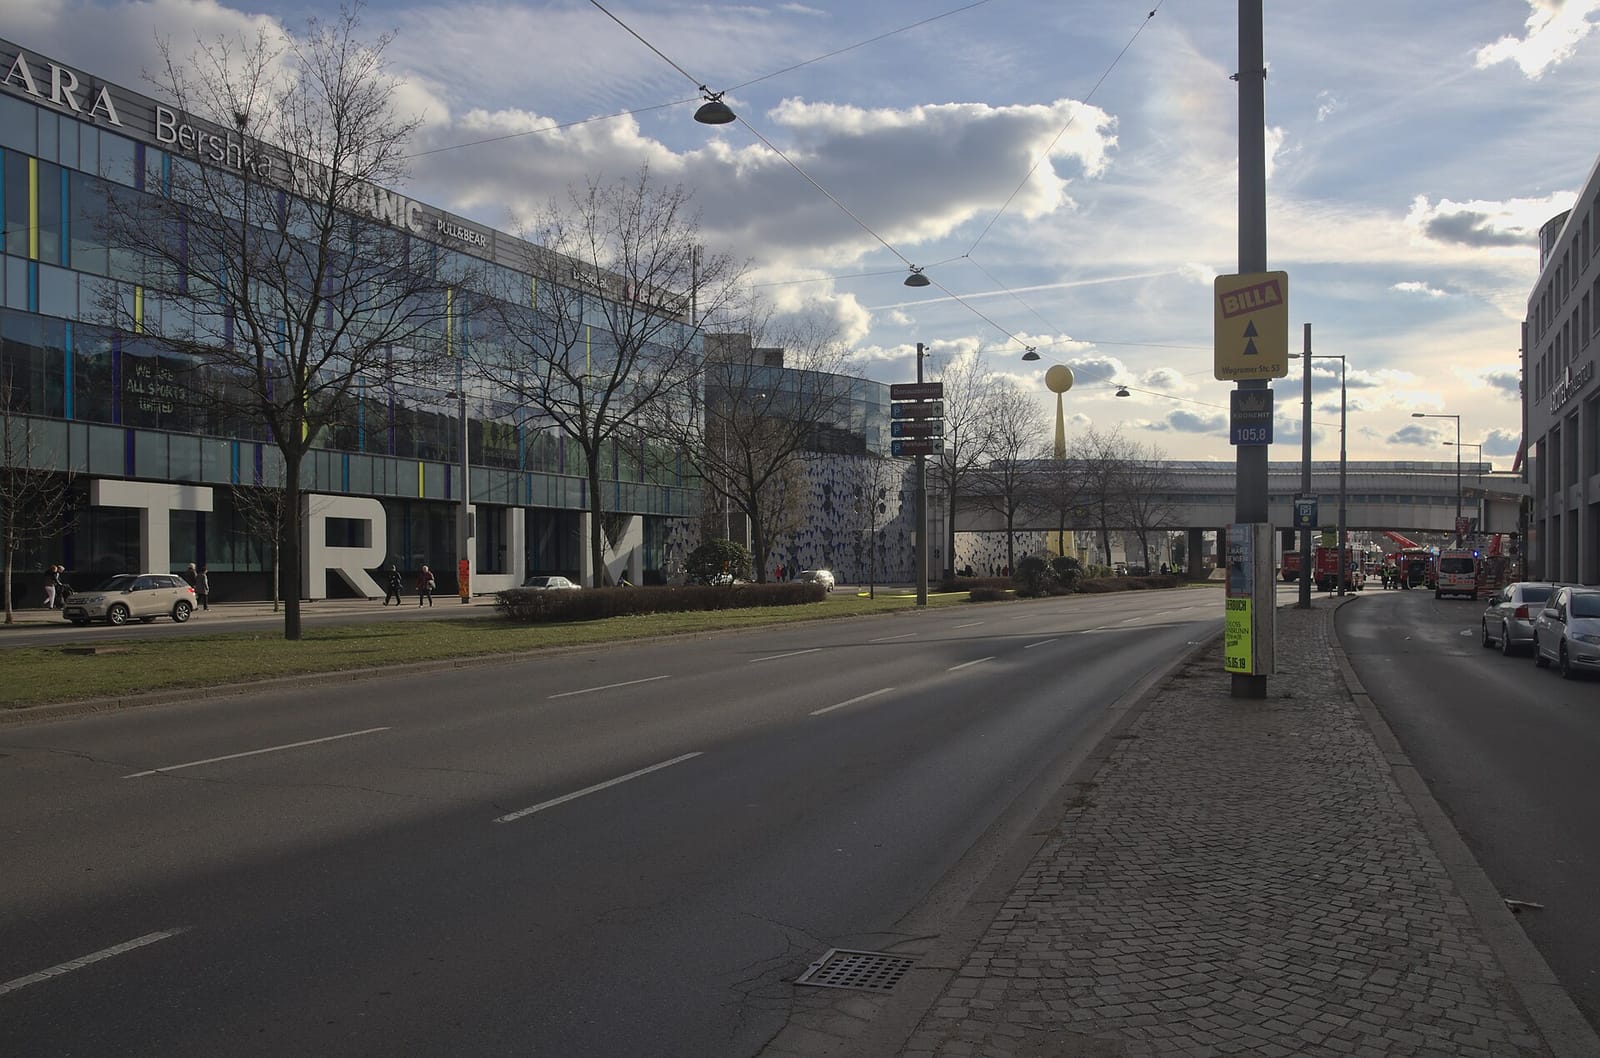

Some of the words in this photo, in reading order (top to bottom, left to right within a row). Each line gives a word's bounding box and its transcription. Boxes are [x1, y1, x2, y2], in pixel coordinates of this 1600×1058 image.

[156, 105, 272, 178] Bershka
[437, 219, 486, 247] PULL&BEAR
[1223, 285, 1280, 313] BILLA
[136, 363, 151, 378] WE
[127, 379, 144, 394] ALL
[147, 383, 186, 400] SPORTS
[1236, 428, 1267, 441] 105.8
